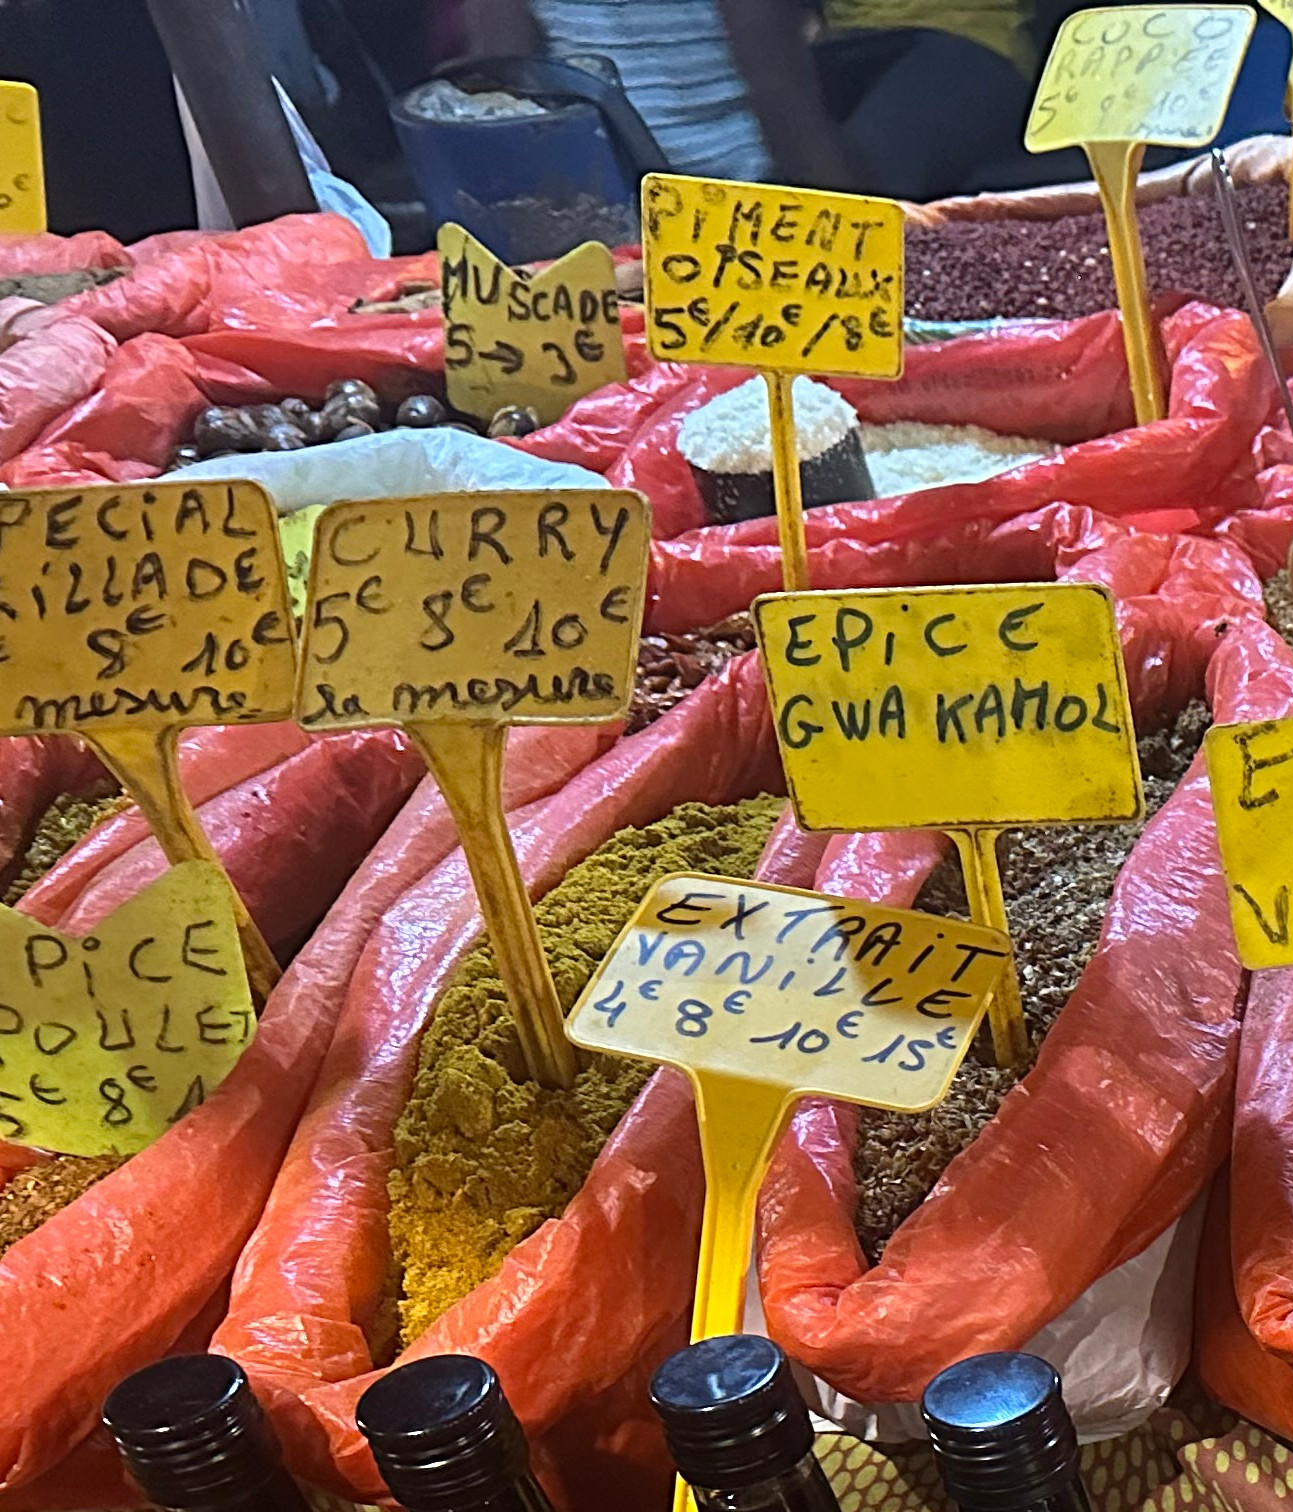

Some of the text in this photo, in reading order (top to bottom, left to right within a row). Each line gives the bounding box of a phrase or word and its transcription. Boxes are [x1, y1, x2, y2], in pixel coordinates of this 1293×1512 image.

[442, 254, 619, 324] MUSCADE
[330, 502, 629, 575] CURRY
[779, 676, 1121, 749] GWA KAMOL
